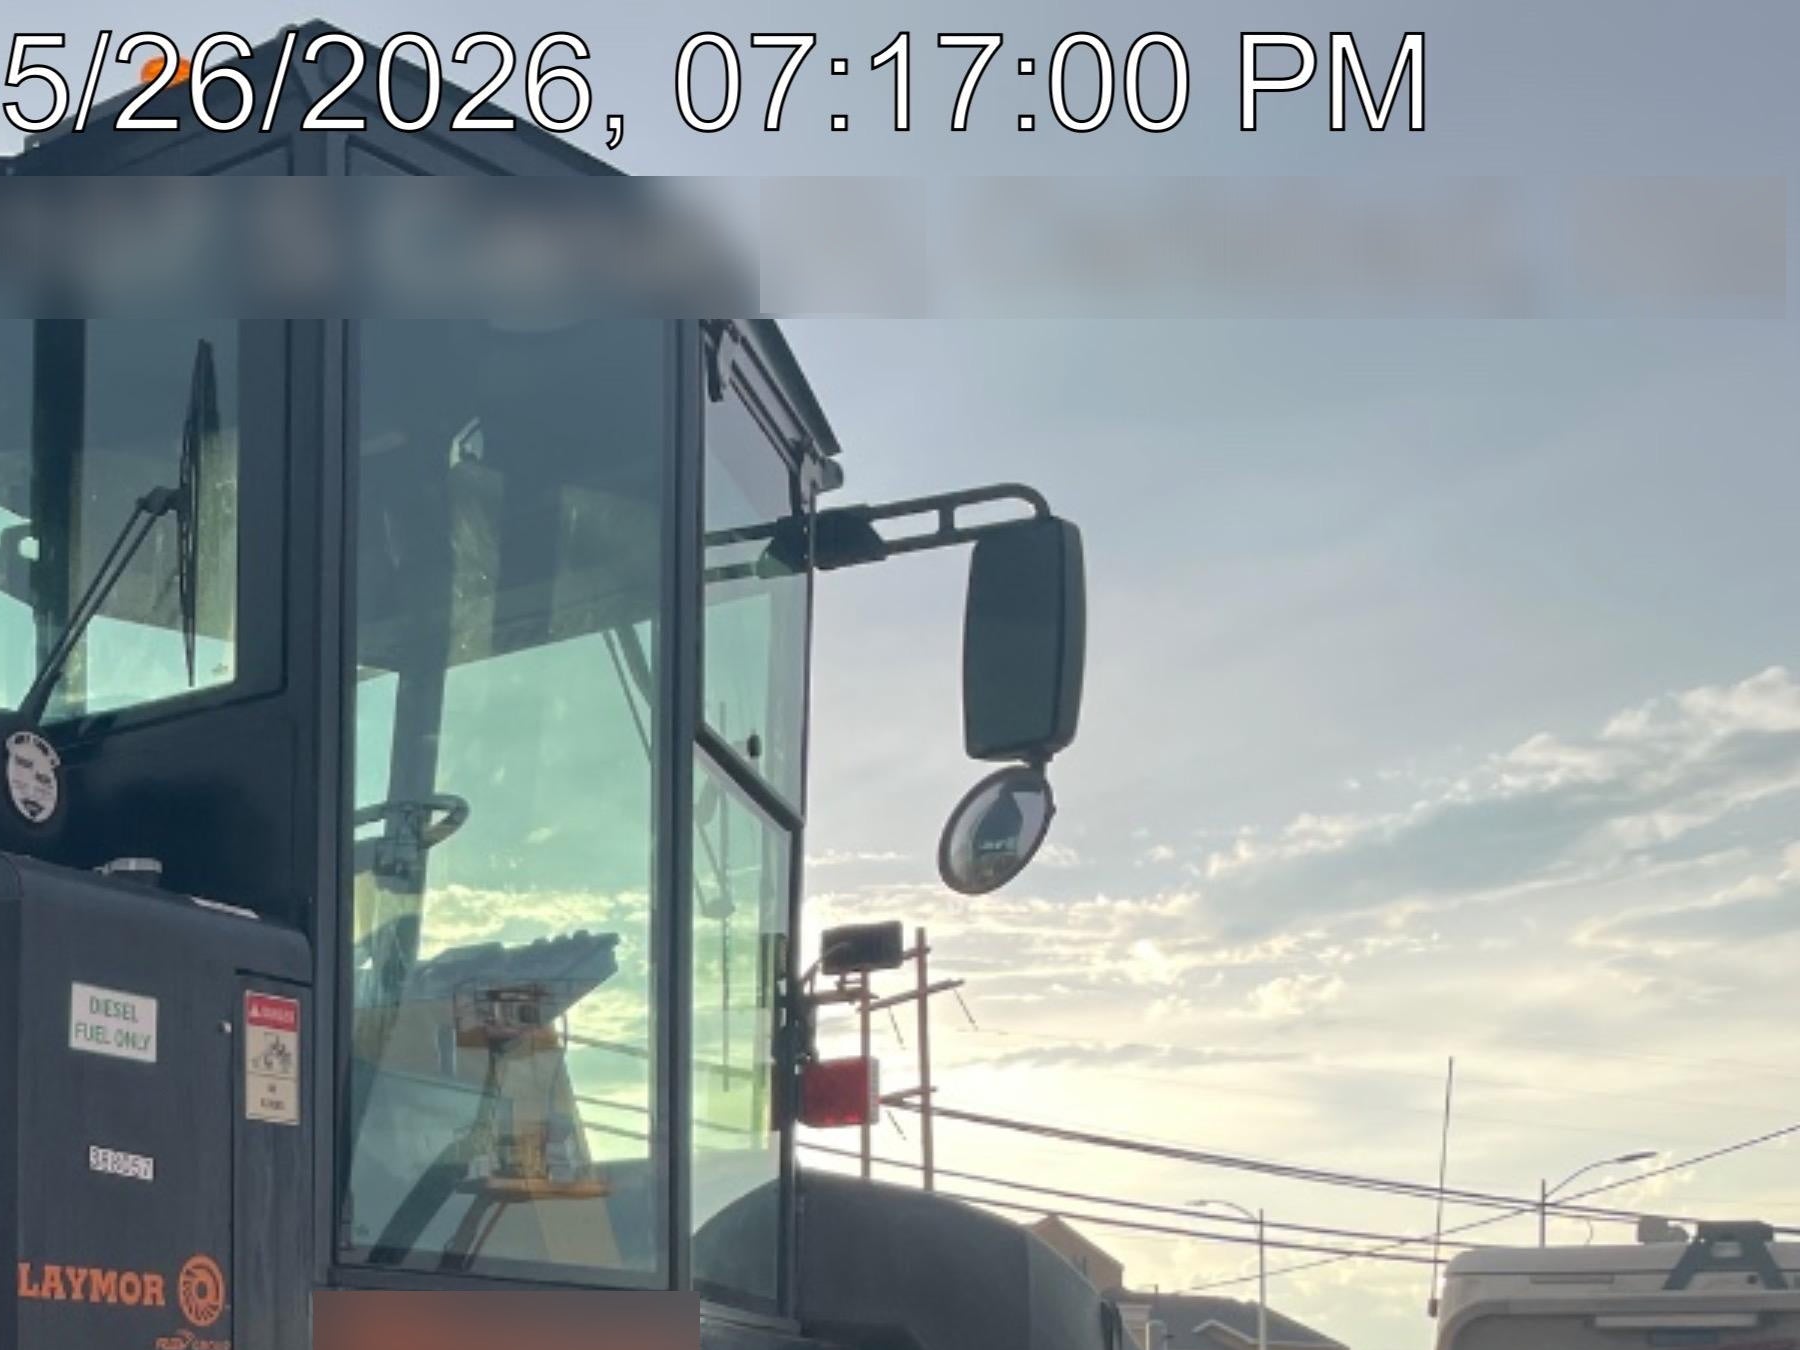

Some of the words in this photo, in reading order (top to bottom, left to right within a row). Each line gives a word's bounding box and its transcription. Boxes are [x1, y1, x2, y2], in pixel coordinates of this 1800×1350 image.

[88, 995, 138, 1023] DIESEL
[74, 1022, 112, 1045] FUEL
[114, 1029, 152, 1051] ONLY
[17, 1262, 166, 1307] LAYMOR
